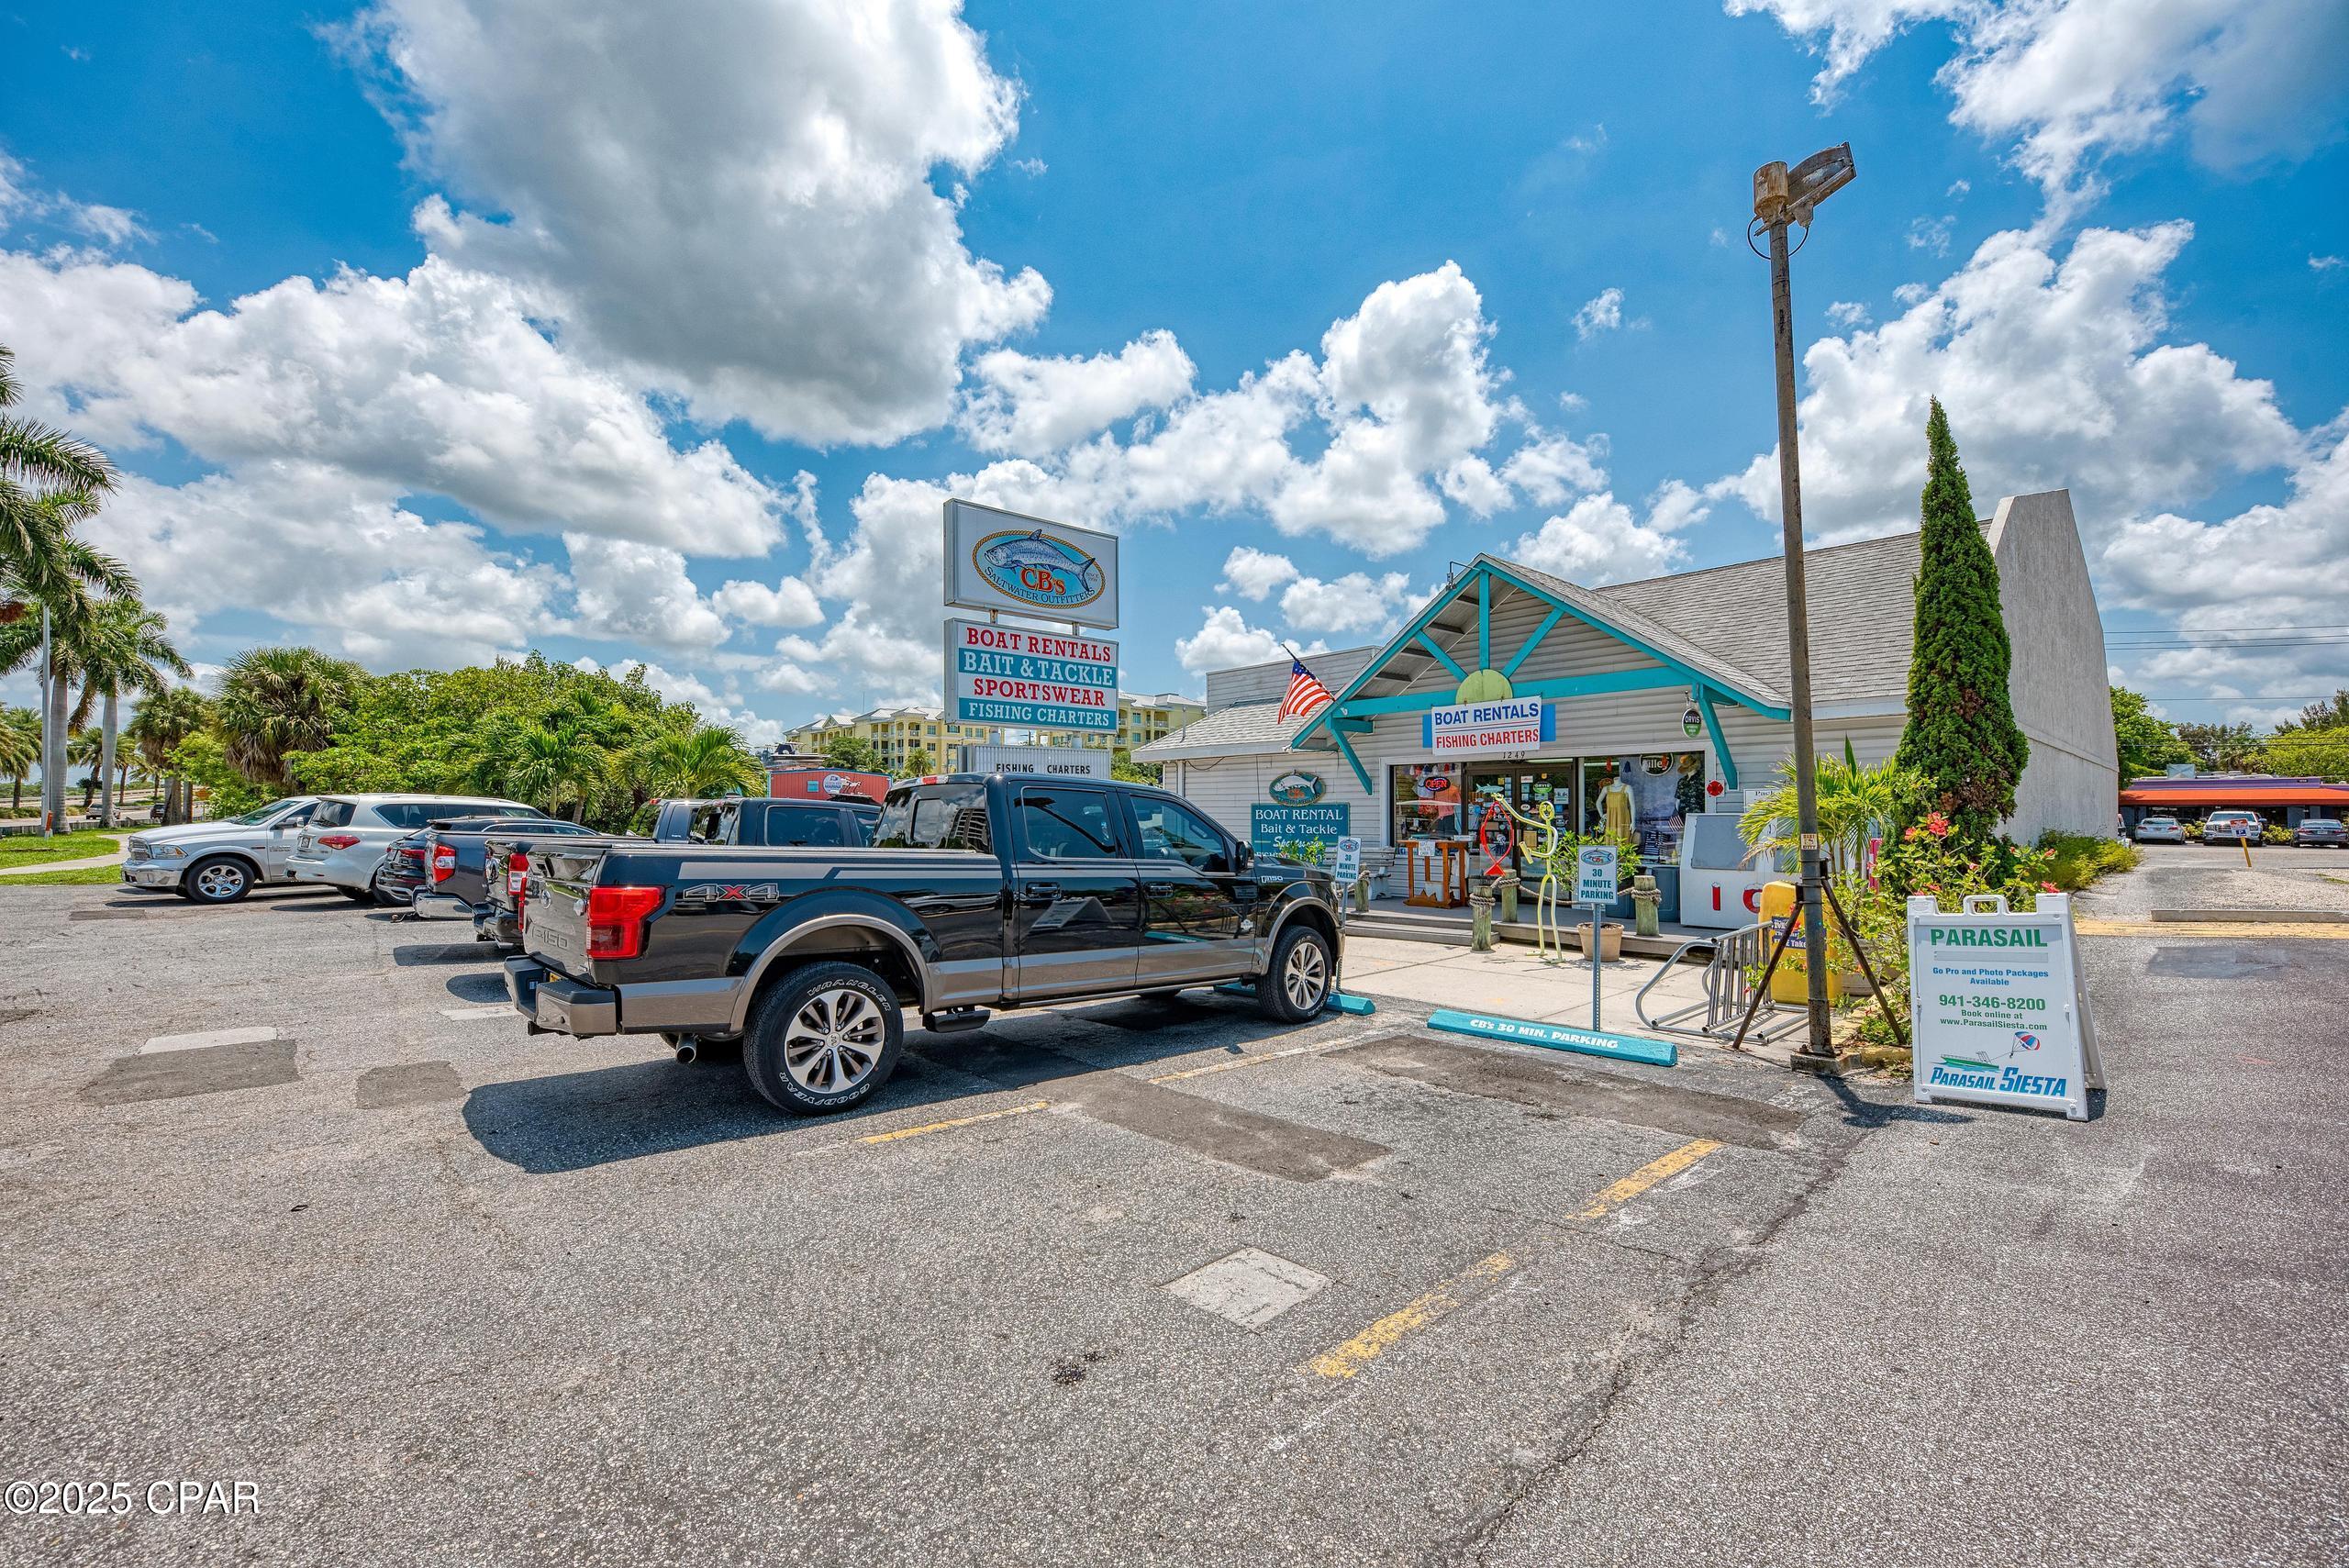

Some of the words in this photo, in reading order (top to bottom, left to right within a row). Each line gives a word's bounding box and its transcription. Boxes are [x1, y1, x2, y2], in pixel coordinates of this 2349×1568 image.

[985, 567, 1039, 600] SALTWATER
[1041, 588, 1095, 604] OUTFITTERS
[1020, 569, 1065, 595] CB's
[967, 628, 1021, 650] BOAT
[1028, 636, 1110, 662] RENTALS
[963, 651, 1013, 675] BAIT
[1021, 659, 1033, 677] &
[1038, 661, 1113, 686] TACKLE
[974, 678, 1105, 706] SPORTSWEAR
[968, 703, 1031, 721] FISHING
[1037, 707, 1109, 727] CHARTERS
[1434, 710, 1468, 726] BOAT
[1473, 702, 1539, 723] RENTALS
[1436, 733, 1476, 749] FISHING
[1479, 728, 1539, 745] CHARTERS
[1503, 751, 1526, 759] 1249
[996, 763, 1033, 773] FISHING
[1047, 764, 1090, 774] CHARTERS
[1425, 780, 1448, 788] OPEN
[1255, 809, 1288, 820] BOAT
[1292, 809, 1343, 820] RENTAL
[1261, 824, 1283, 834] Bait
[1286, 824, 1296, 834] &
[1299, 824, 1338, 834] Tackle
[1339, 862, 1356, 871] MINUTE
[1592, 869, 1602, 877] 30
[1337, 871, 1357, 880] PARKING
[1583, 879, 1612, 889] MINUTE
[1581, 890, 1614, 899] PARKING
[1931, 929, 2047, 948] PARASAIL
[1932, 967, 1943, 975] Go
[1945, 967, 1959, 975] Pro
[1978, 968, 2004, 976] Photo
[2006, 969, 2049, 978] Packages
[1970, 977, 2009, 986] Available
[807, 979, 891, 1011] WRANGLER
[1939, 995, 2046, 1011] 941-346-8200
[1985, 1011, 2011, 1019] online
[1940, 1018, 2047, 1030] www.ParasailSiesta.com
[1470, 1019, 1494, 1030] CB's
[1497, 1023, 1514, 1033] 30
[1518, 1027, 1547, 1039] MIN.
[1552, 1031, 1618, 1049] PARKING
[1931, 1067, 1996, 1089] PARASAIL
[1999, 1066, 2067, 1096] SIESTA
[779, 1072, 870, 1106] GOODYEAR
